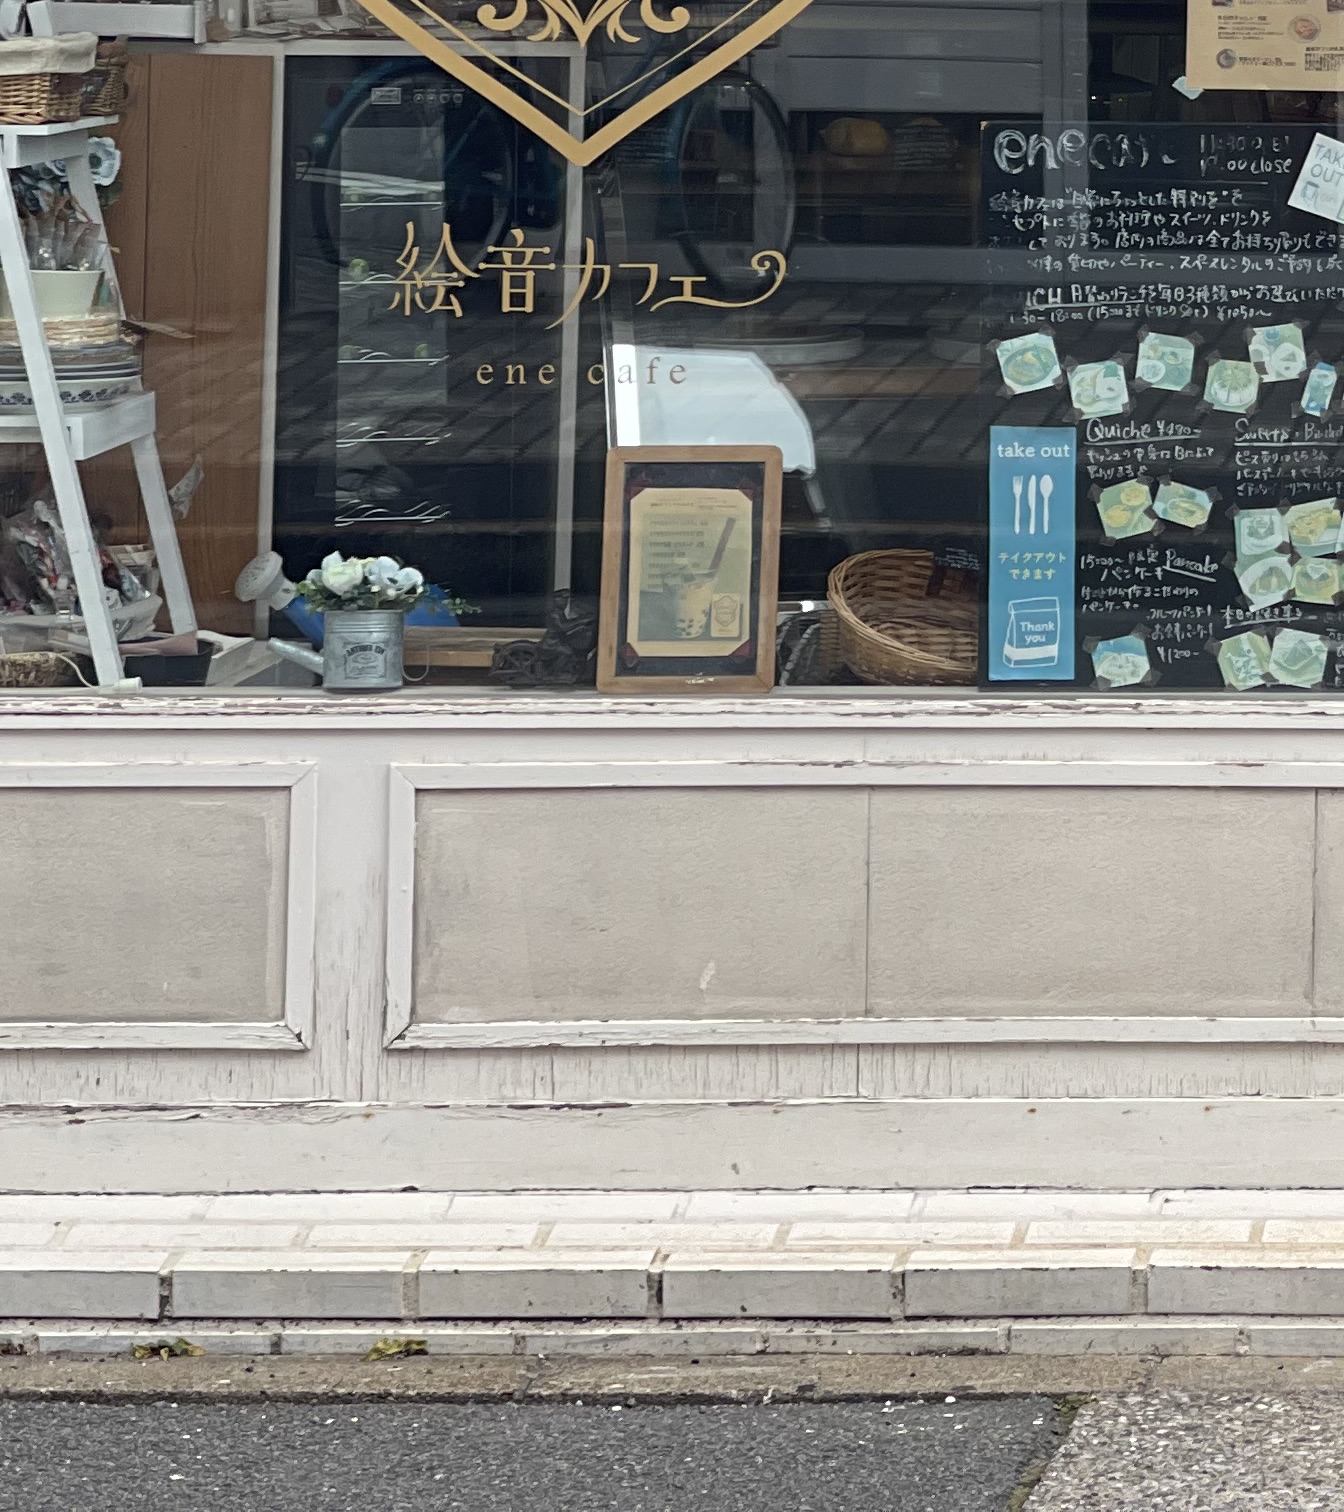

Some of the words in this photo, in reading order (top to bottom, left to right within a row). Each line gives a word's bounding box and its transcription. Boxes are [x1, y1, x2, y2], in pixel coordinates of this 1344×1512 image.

[388, 221, 786, 330] 絵音カフェ
[476, 362, 556, 385] ene
[587, 357, 688, 385] cafe
[1086, 417, 1151, 441] Quiche
[997, 442, 1036, 458] take
[1040, 444, 1071, 458] out
[998, 552, 1066, 565] テイクアウト
[1009, 568, 1055, 580] できます
[1019, 621, 1055, 632] Thank
[1024, 633, 1047, 644] you
